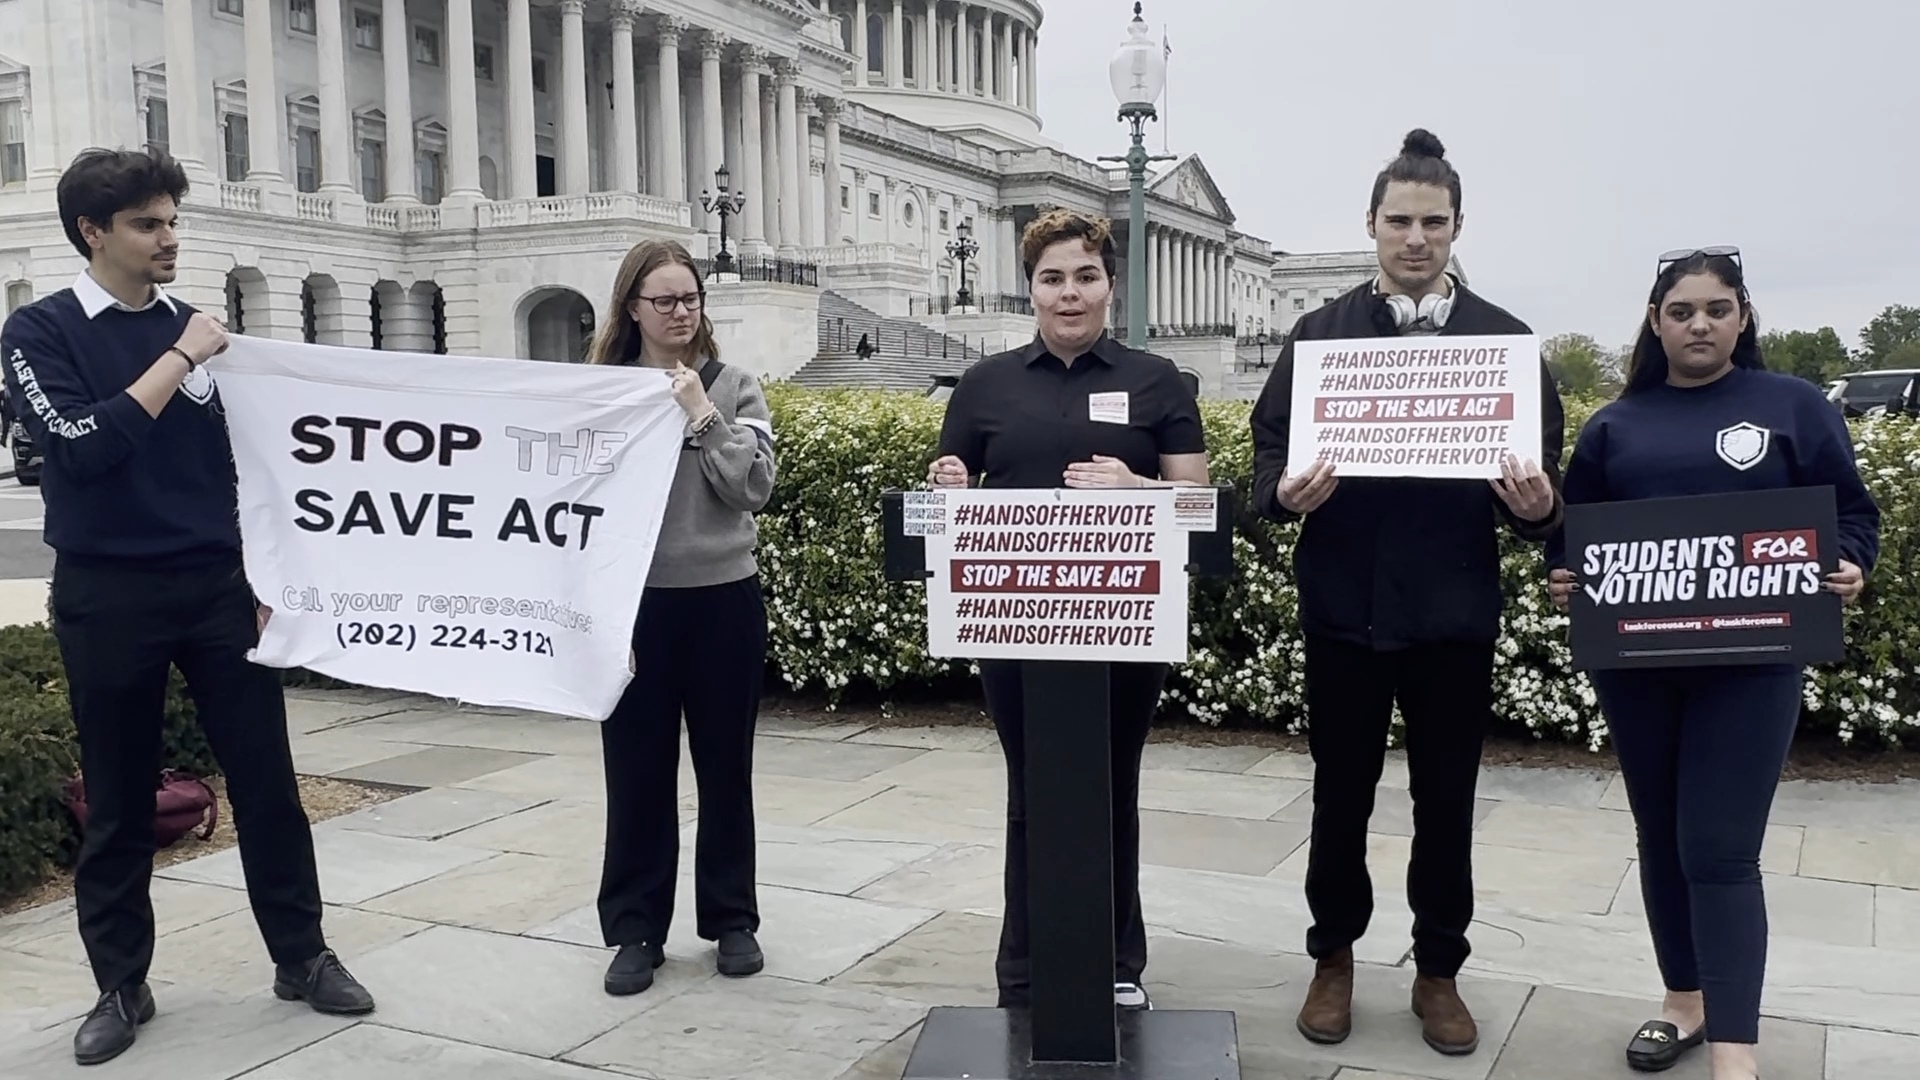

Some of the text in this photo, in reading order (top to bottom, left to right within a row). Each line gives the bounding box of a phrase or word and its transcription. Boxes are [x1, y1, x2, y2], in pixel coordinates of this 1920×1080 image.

[1320, 348, 1509, 370] #HANDSOFFHERVOTE
[1319, 370, 1509, 392] #HANDSOFFHERVOTE
[1324, 398, 1500, 419] STOP THE SAVE ACT
[291, 415, 628, 476] STOP THE
[1317, 425, 1509, 444] #HANDSOFFHERVOTE
[294, 489, 605, 551] SAVE ACT
[954, 505, 1156, 527] #HANDSOFFHERVOTE
[954, 532, 1156, 553] #HANDSOFFHERVOTE
[1583, 535, 1809, 576] STUDENTS FOR
[961, 564, 1147, 588] STOP THE SAVE ACT
[1706, 562, 1822, 600] RIGHTS
[331, 592, 403, 617] your
[955, 598, 1155, 621] #HANDSOFFHERVOTE
[336, 622, 417, 651] (202)
[956, 624, 1155, 647] #HANDSOFFHERVOTE
